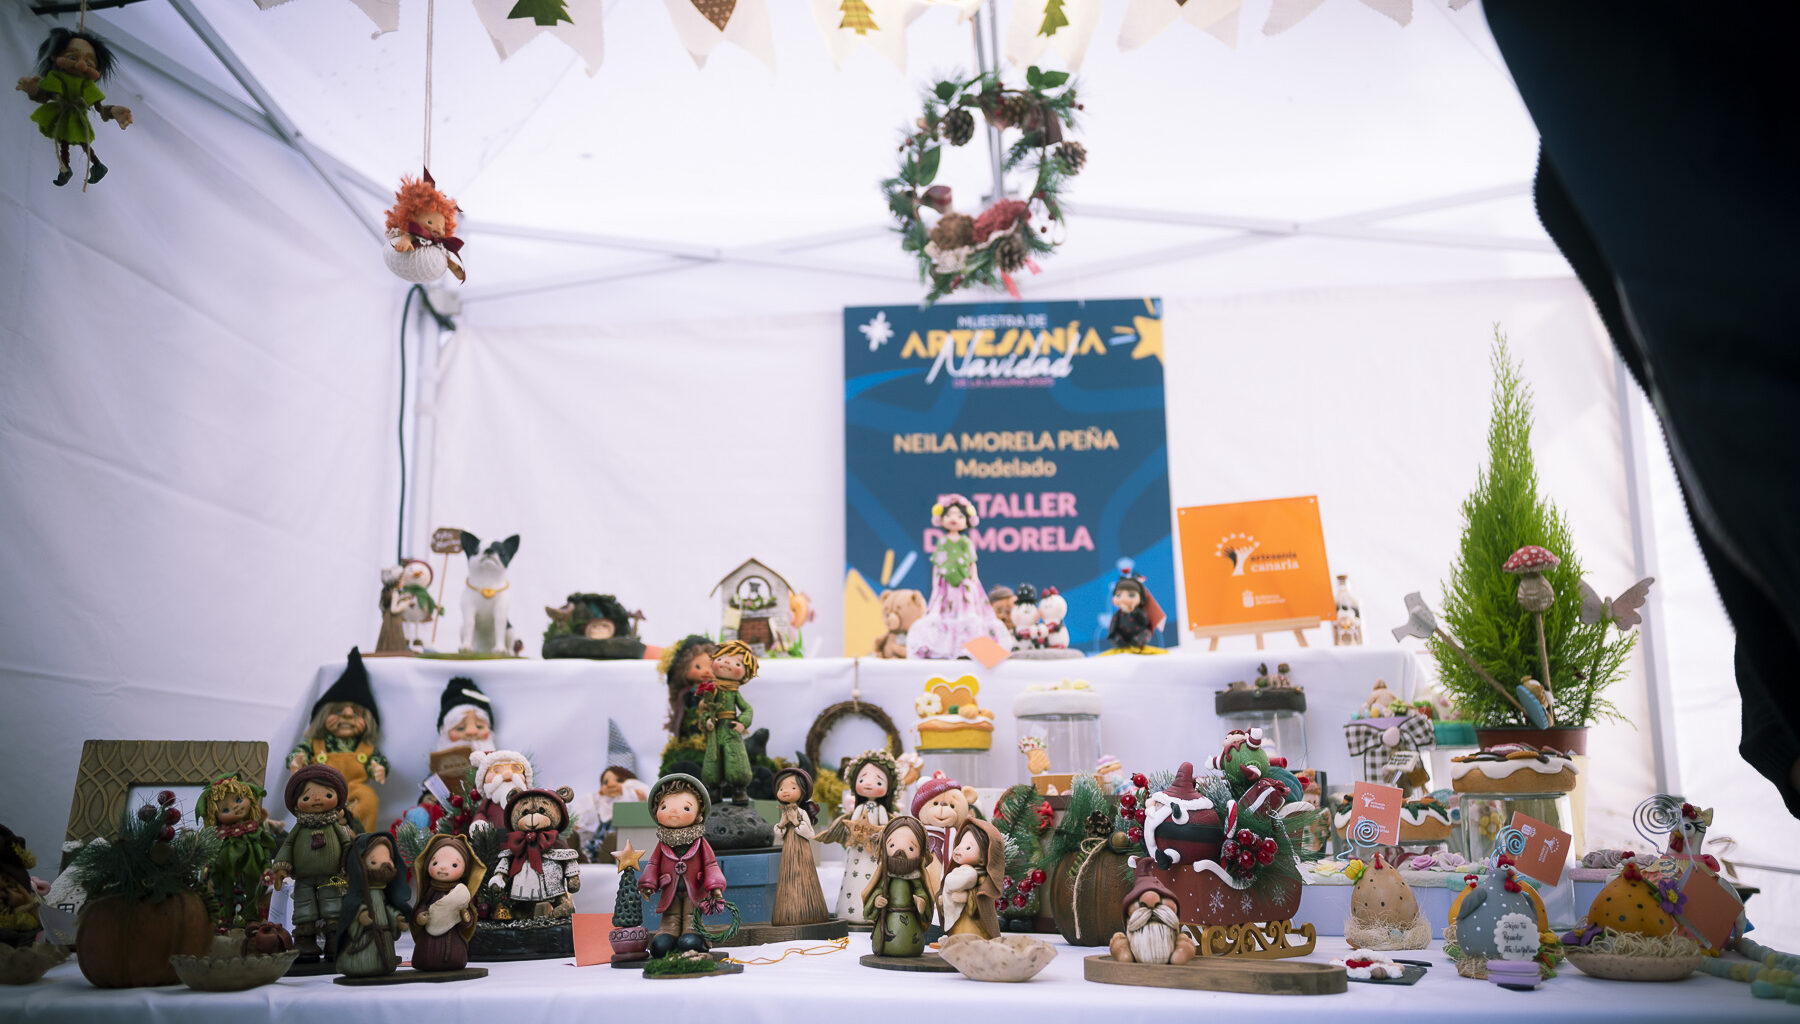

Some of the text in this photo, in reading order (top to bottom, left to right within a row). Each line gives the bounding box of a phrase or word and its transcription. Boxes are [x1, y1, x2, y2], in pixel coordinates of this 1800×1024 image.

[957, 313, 1048, 329] MUESTRA DE
[900, 320, 1107, 359] ARTESANÍA
[925, 330, 1081, 385] Navidad
[893, 426, 1120, 454] NEILA MORELA PEÑA
[955, 456, 1058, 479] Modelado
[972, 491, 1078, 518] TALLER
[967, 525, 1095, 552] MORELA
[1250, 559, 1300, 573] canaria
